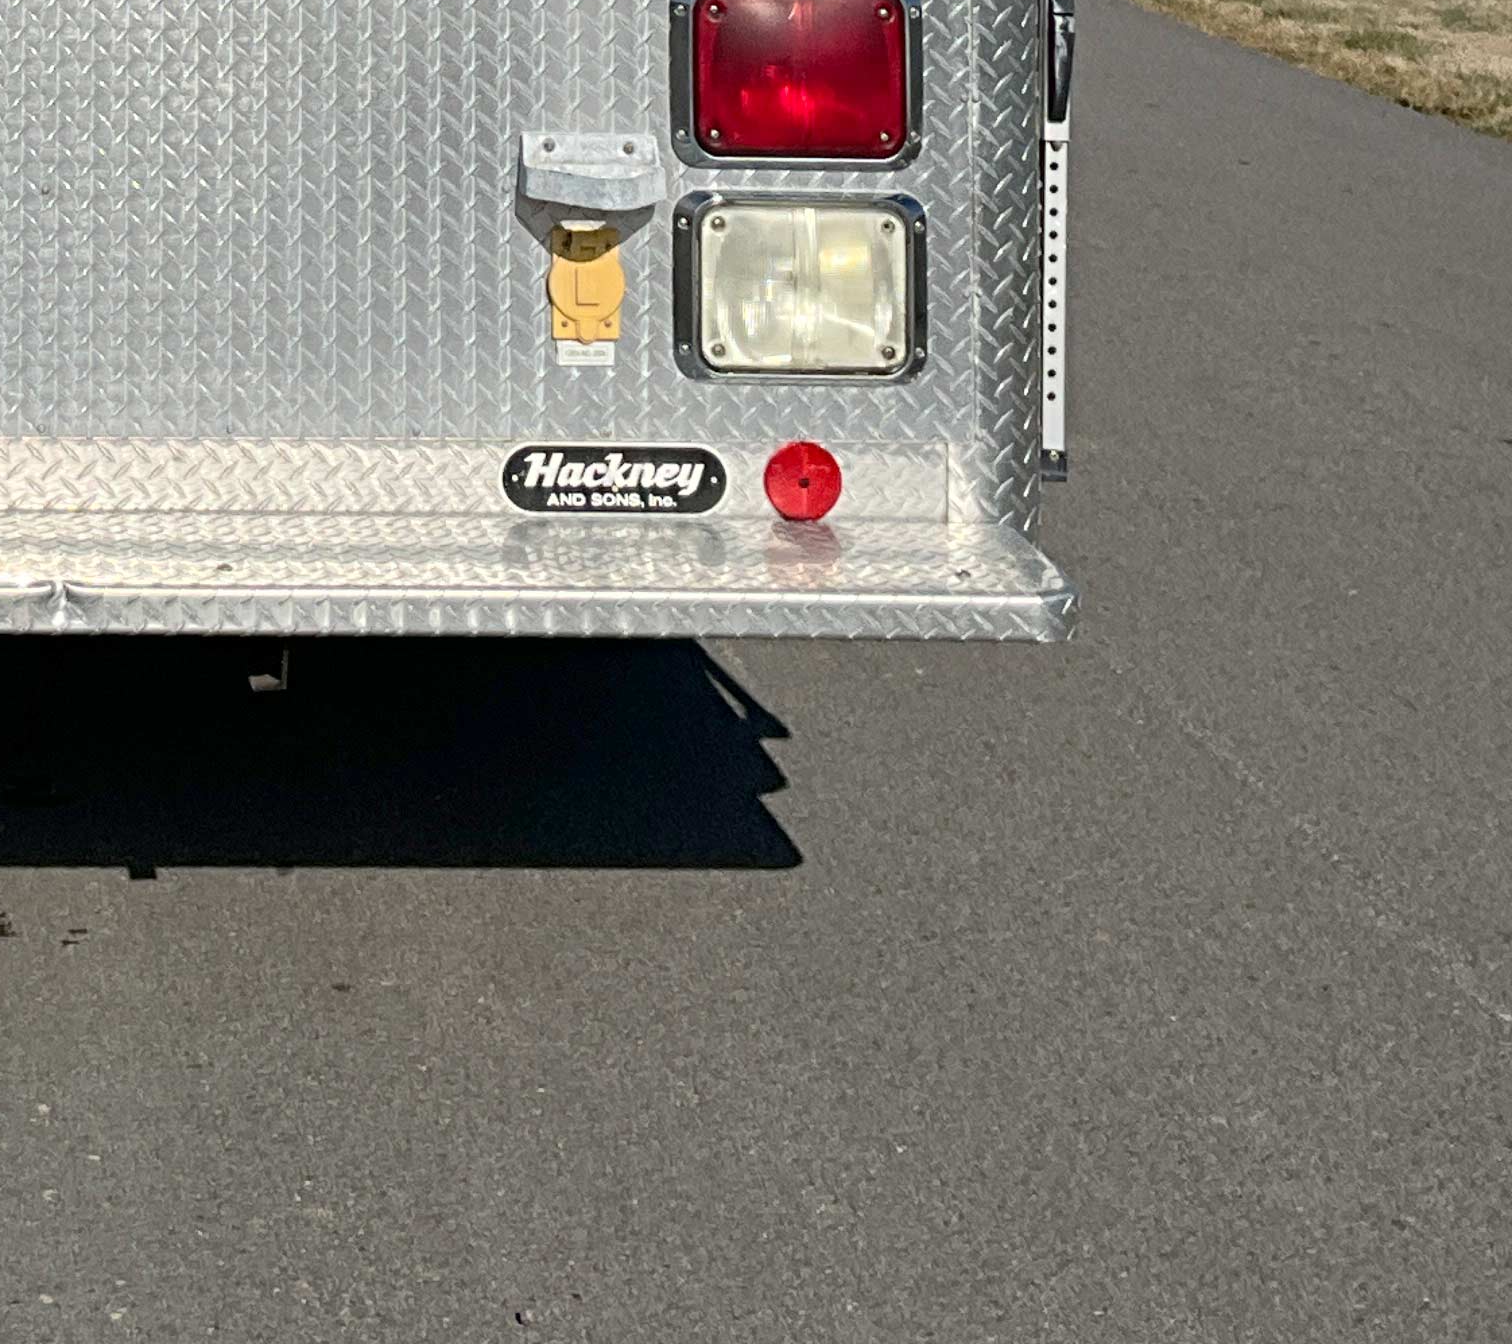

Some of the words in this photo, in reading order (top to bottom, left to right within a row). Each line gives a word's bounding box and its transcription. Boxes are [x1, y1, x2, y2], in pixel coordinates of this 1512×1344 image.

[523, 452, 705, 496] Hackney
[546, 493, 586, 506] AND
[591, 493, 645, 508] SONS,
